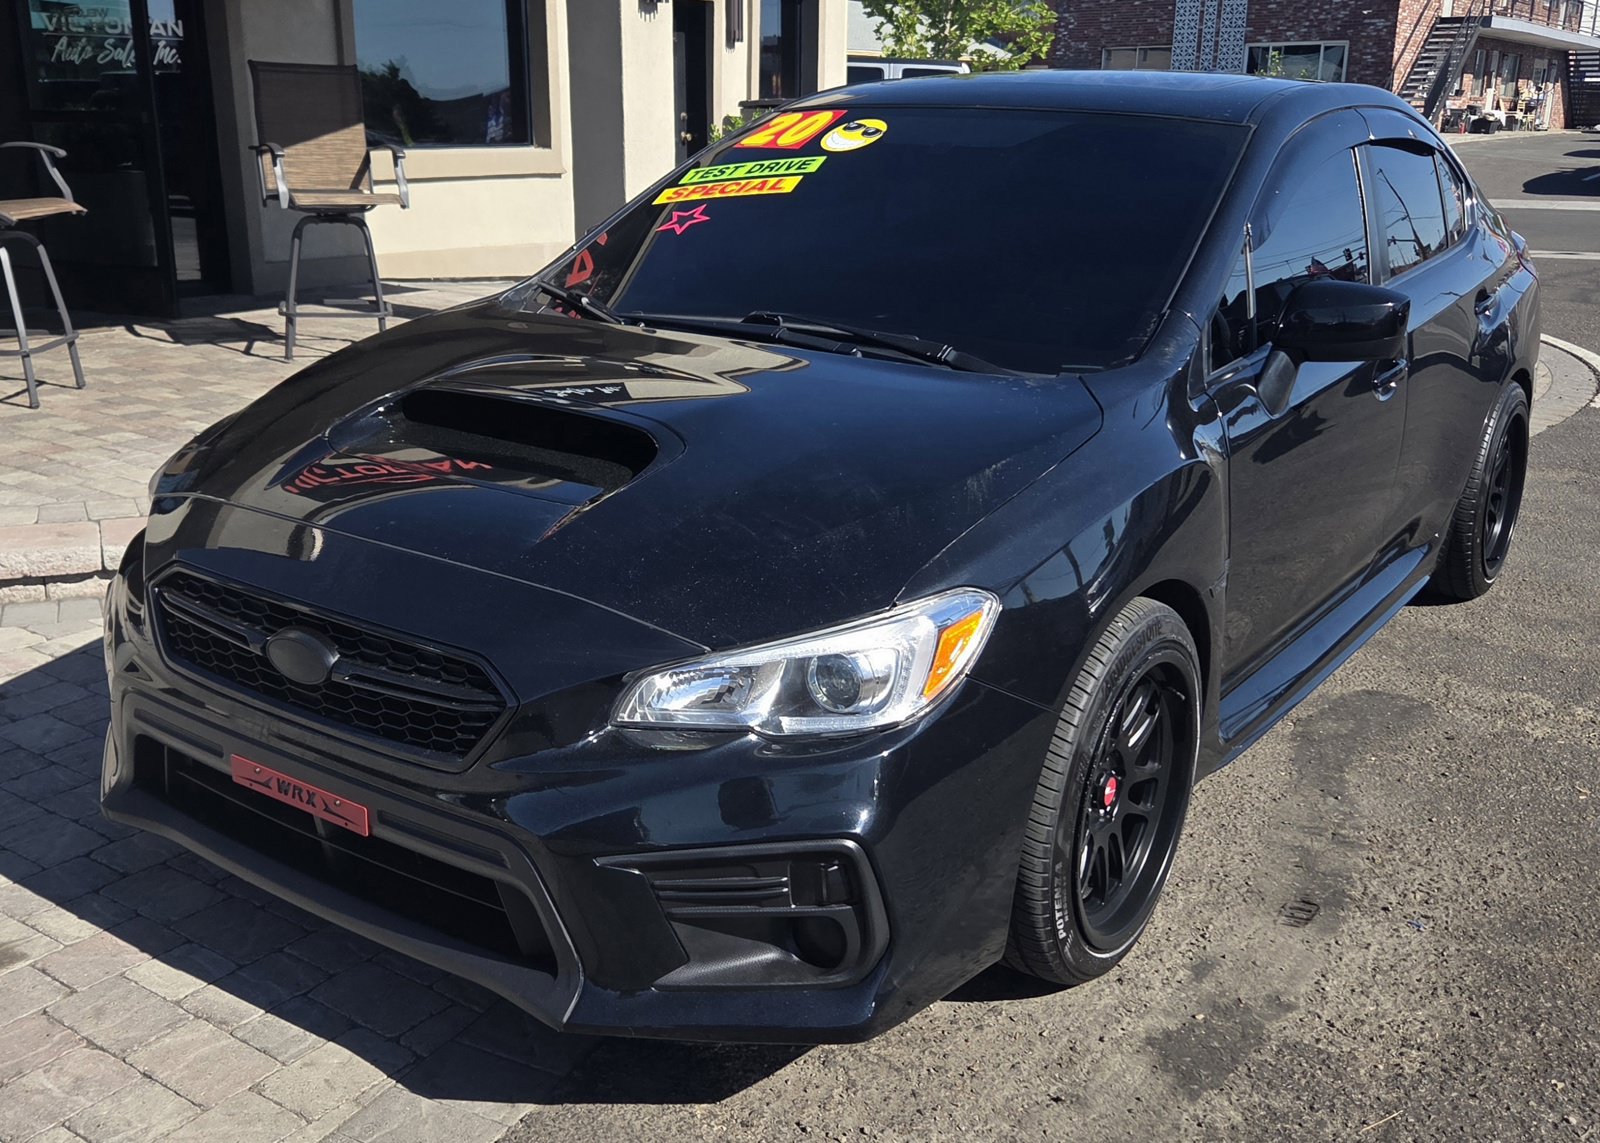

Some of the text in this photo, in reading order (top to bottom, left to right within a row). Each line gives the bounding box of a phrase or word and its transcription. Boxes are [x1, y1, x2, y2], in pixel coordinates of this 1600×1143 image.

[41, 13, 184, 37] VICTOAN
[51, 35, 182, 68] Auto Sal Inc.
[739, 110, 834, 148] 20
[687, 158, 818, 182] TEST DRIVE
[665, 178, 786, 201] SPECIAL
[276, 777, 317, 809] WRX
[1054, 861, 1067, 940] POTENZA
